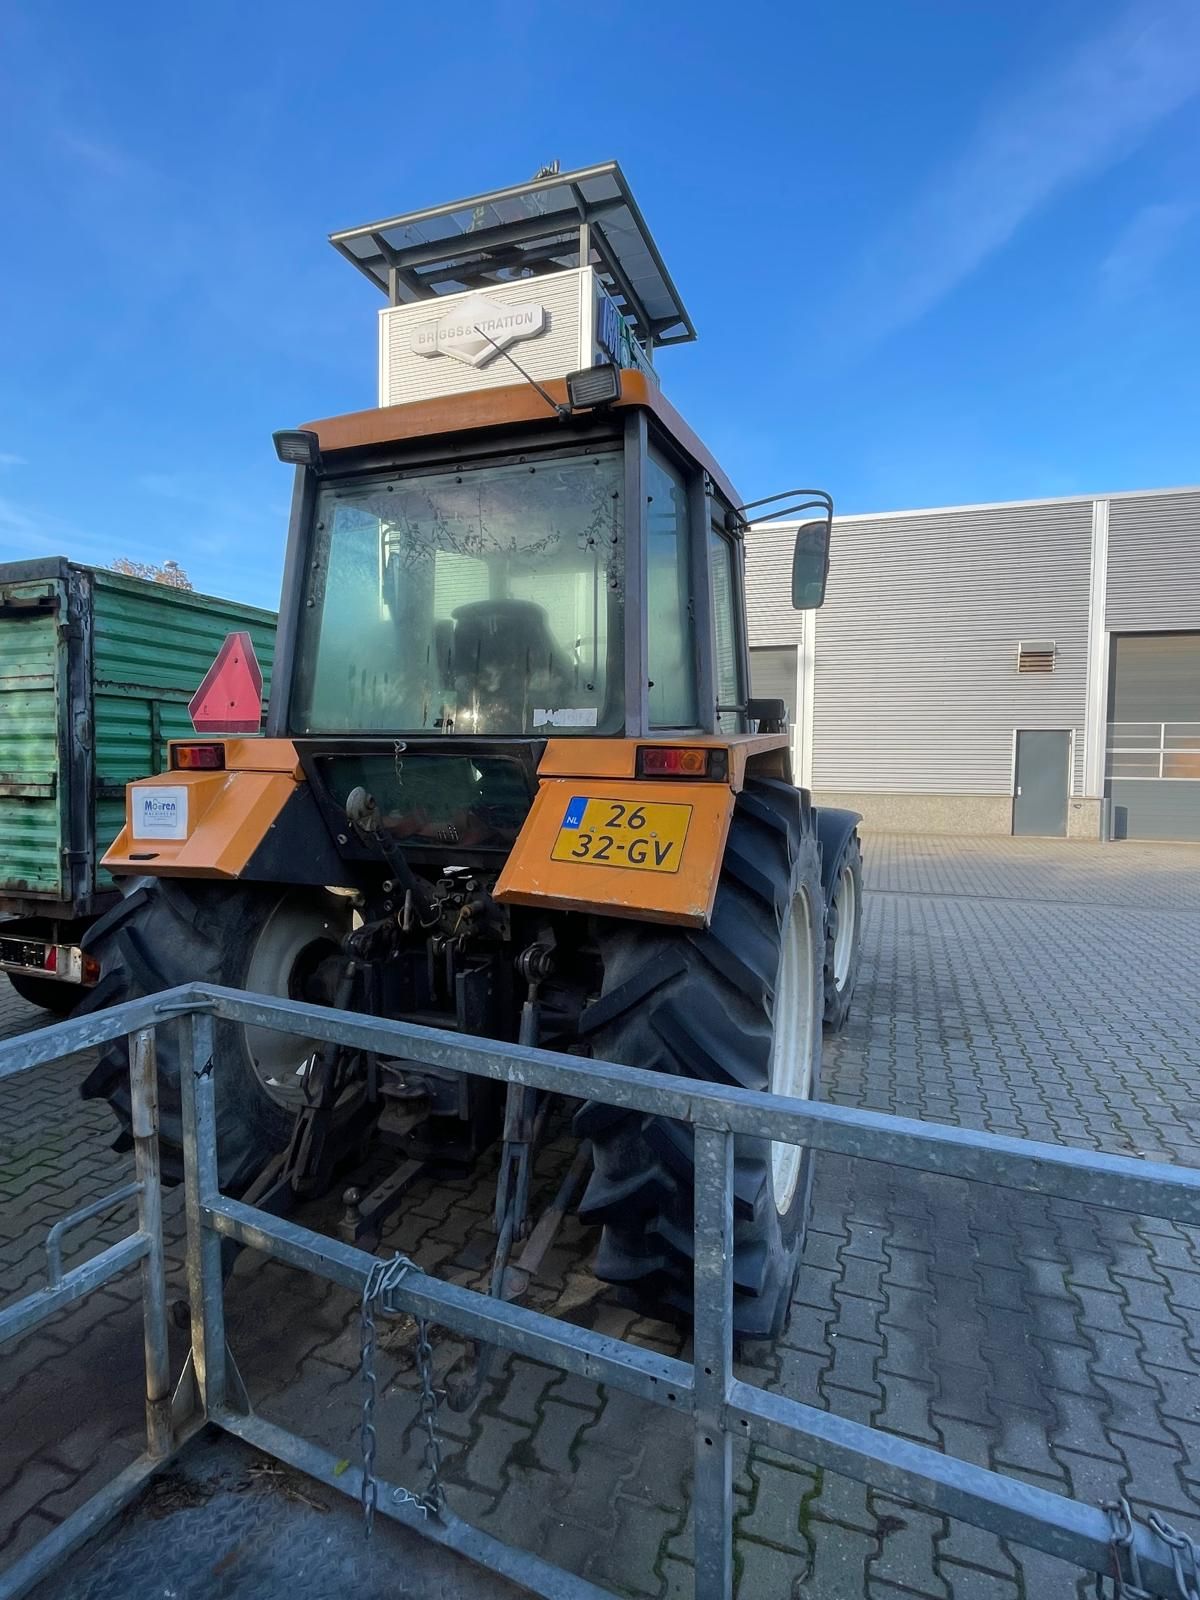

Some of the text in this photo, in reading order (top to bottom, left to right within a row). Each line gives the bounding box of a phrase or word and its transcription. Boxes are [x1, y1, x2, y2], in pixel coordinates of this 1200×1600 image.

[566, 817, 579, 825] NL
[605, 804, 646, 830] 26
[571, 834, 674, 866] 32-GV
